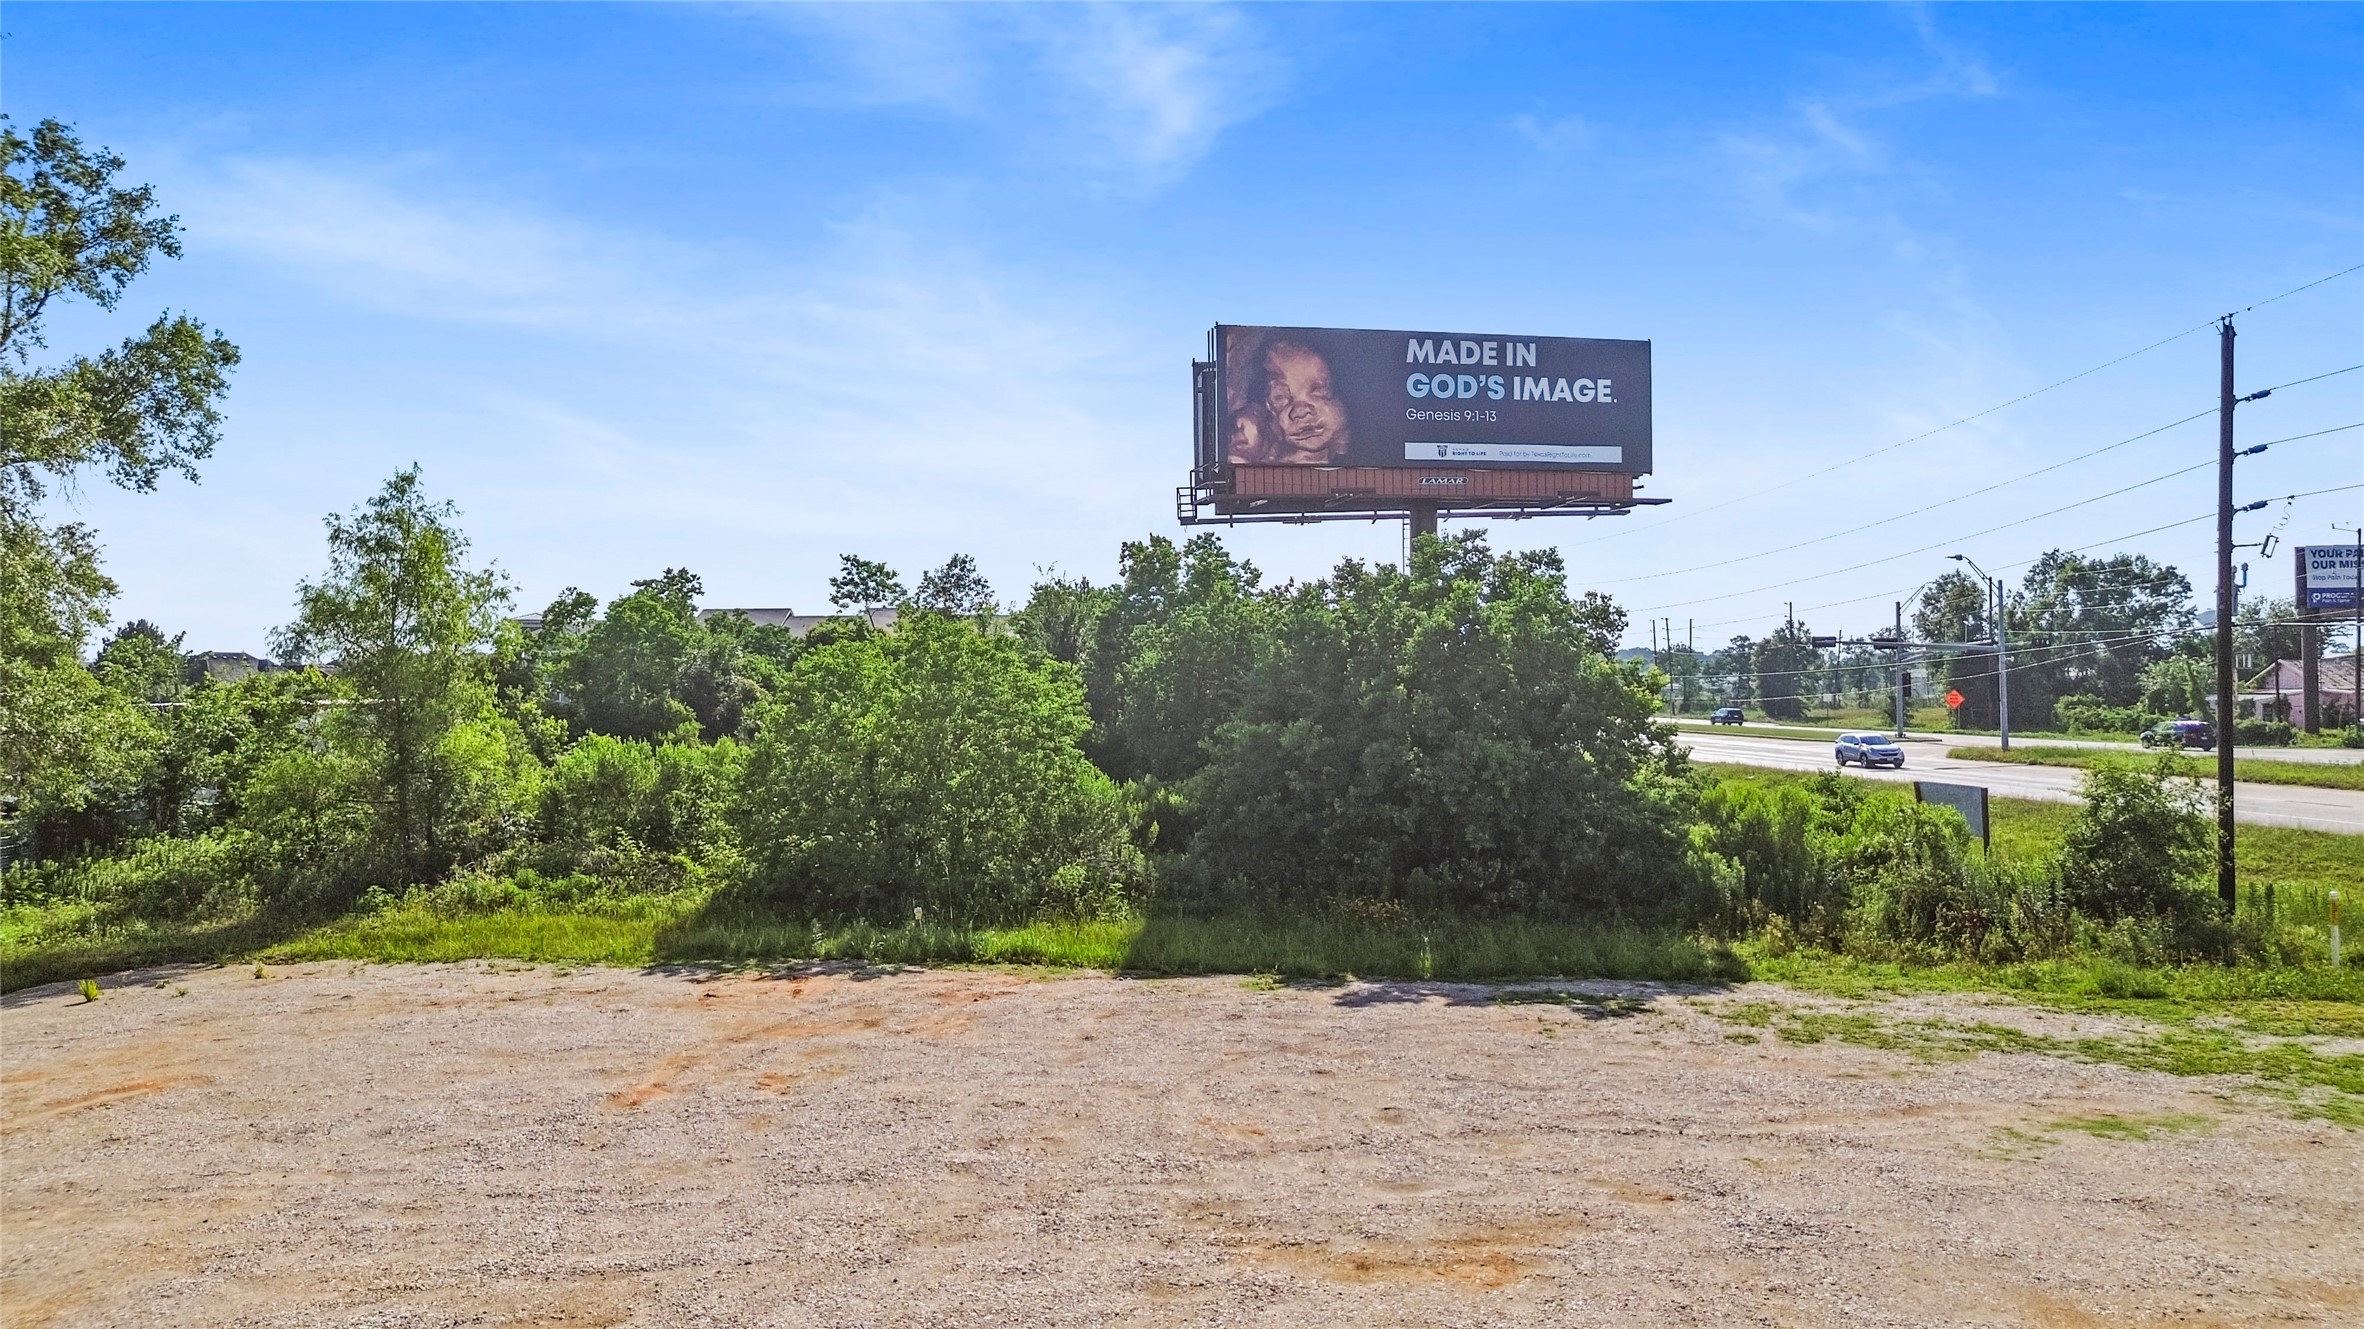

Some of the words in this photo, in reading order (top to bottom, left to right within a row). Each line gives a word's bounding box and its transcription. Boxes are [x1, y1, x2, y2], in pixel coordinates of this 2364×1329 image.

[1406, 338, 1498, 365] MADE
[1506, 342, 1536, 367] IN
[1406, 372, 1505, 400] GOD’S
[1513, 376, 1618, 403] IMAGE.
[1406, 408, 1461, 421] Genesis
[1464, 410, 1497, 422] 9:1-13
[1422, 477, 1464, 485] LAMAR
[2310, 549, 2343, 558] YOUR
[2312, 560, 2336, 569] OUR
